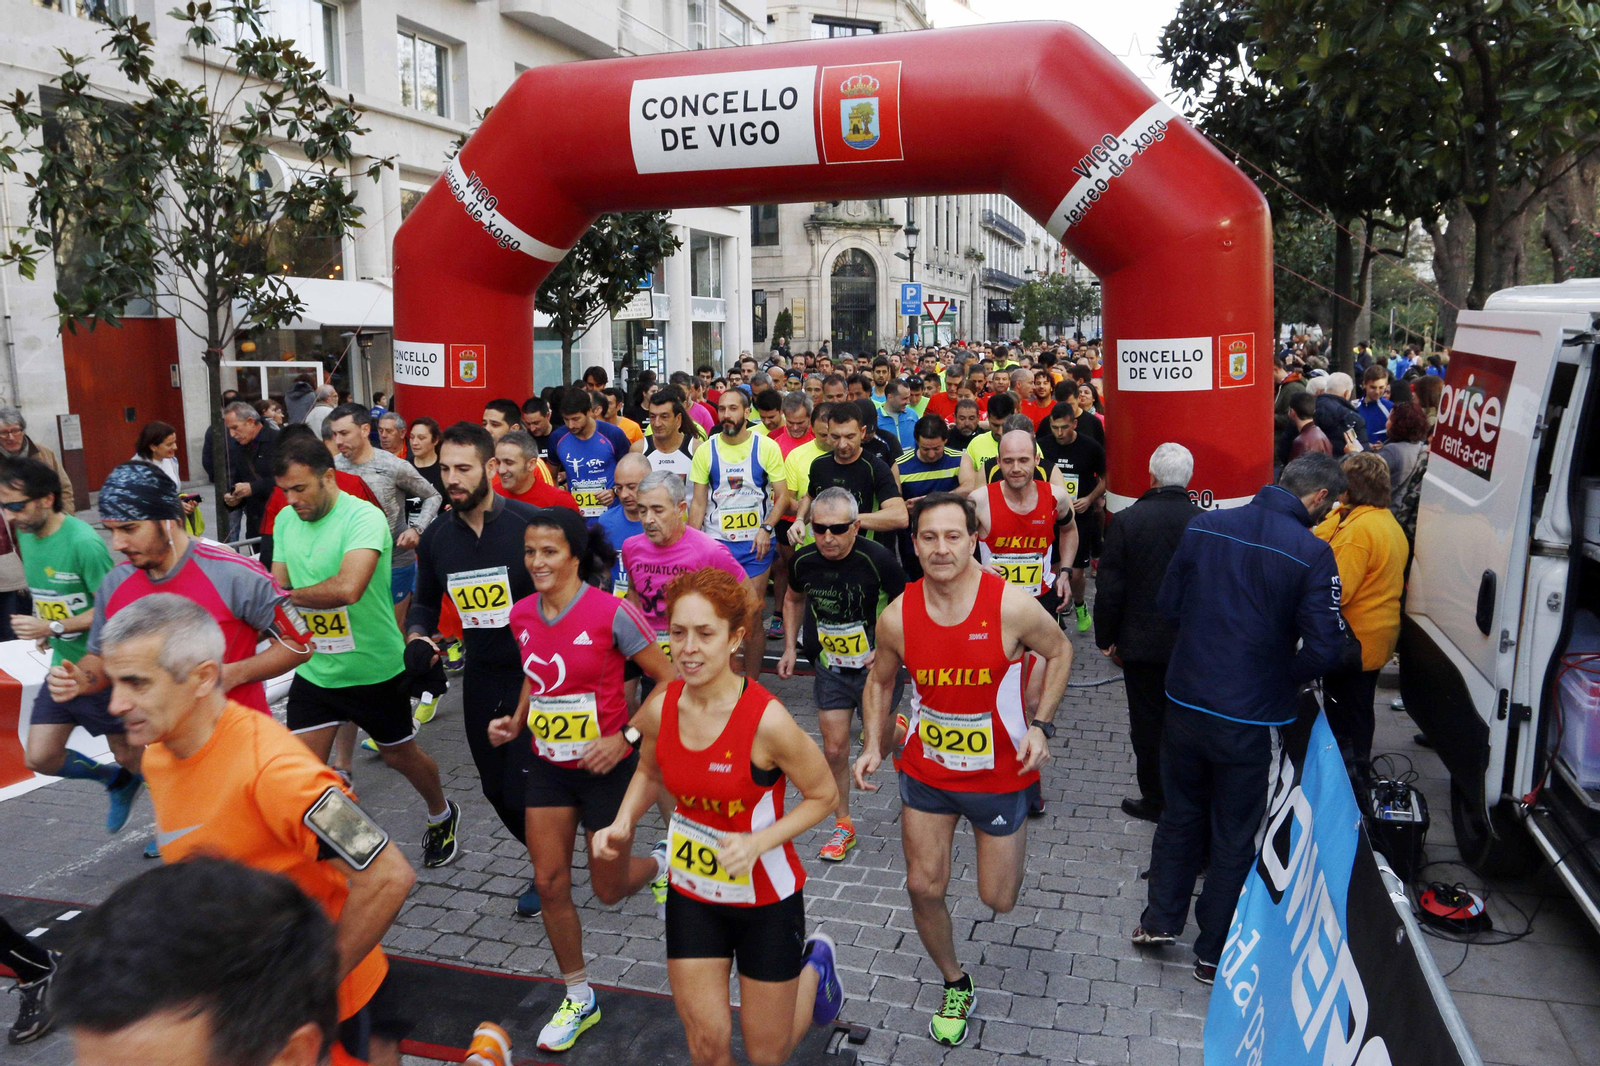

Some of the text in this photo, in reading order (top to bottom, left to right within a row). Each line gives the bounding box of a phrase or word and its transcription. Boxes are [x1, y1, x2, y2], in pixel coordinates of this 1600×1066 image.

[641, 86, 799, 121] CONCELLO
[661, 120, 780, 152] DE VIGO
[1072, 134, 1129, 179] VIGO,
[1064, 119, 1169, 227] terreo de xogo
[445, 163, 521, 251] erreo de xogo
[465, 170, 499, 219] VIGO,
[906, 287, 917, 300] P
[1122, 349, 1203, 363] CONCELLO
[405, 365, 430, 377] VIGO
[1129, 367, 1193, 380] DE VIGO
[1440, 434, 1492, 472] rent-a-car
[1188, 489, 1220, 510] GO,
[724, 512, 758, 530] 210
[994, 536, 1048, 549] BIKILA
[457, 584, 506, 610] 102
[823, 634, 862, 654] 937
[916, 667, 993, 686] BIKILA
[534, 714, 590, 740] 927
[926, 724, 987, 753] 920
[675, 840, 736, 881] 49
[1262, 752, 1392, 1066] OWER
